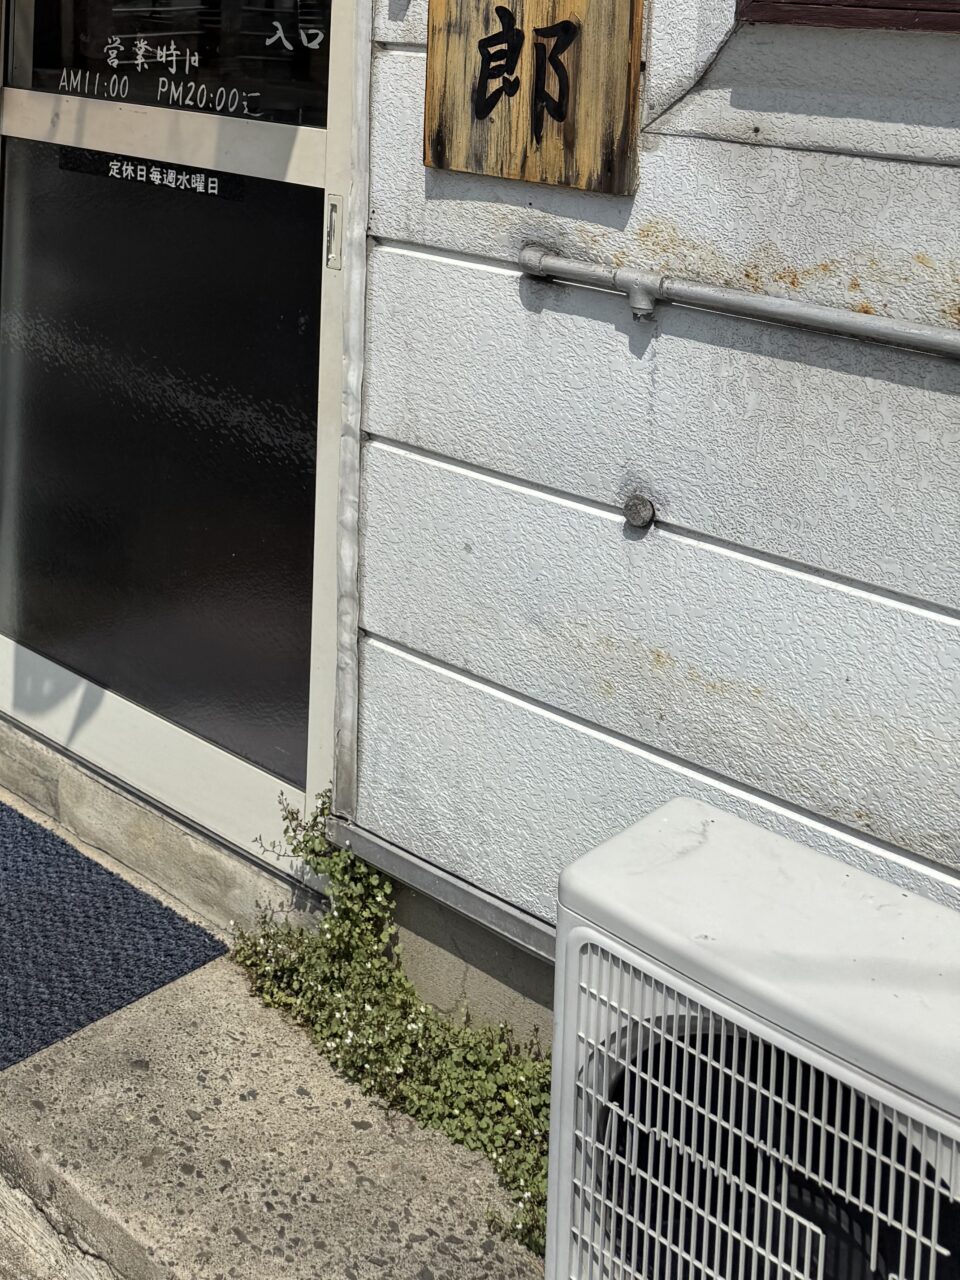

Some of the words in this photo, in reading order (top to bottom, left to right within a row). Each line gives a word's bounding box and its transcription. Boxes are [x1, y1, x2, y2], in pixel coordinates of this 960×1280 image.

[265, 21, 325, 51] 入口
[58, 67, 130, 99] AM11:00
[108, 159, 219, 196] 定休日毎週水曜日
